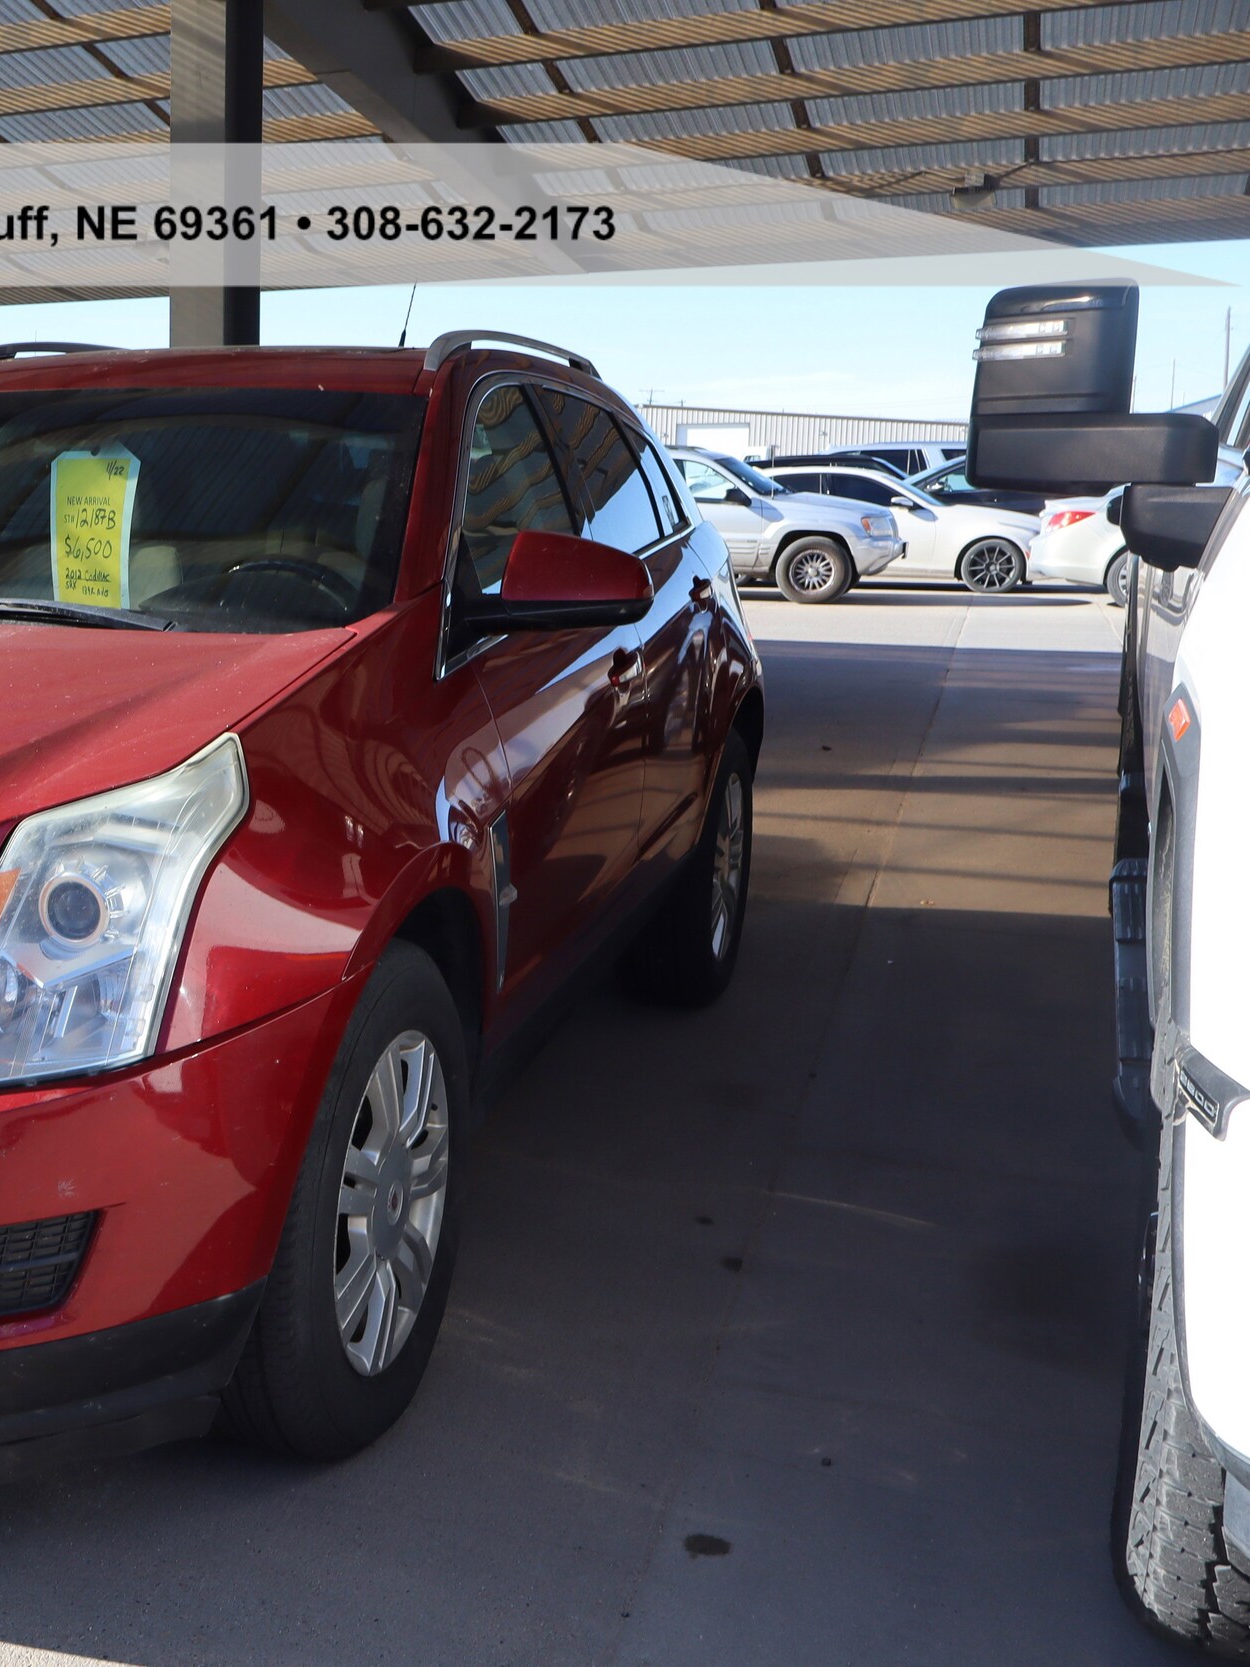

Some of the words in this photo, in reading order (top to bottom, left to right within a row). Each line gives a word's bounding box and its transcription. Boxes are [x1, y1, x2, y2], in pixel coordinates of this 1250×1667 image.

[66, 496, 83, 506] NEW
[84, 496, 111, 506] ARRIVAL
[64, 534, 113, 562] $6,500
